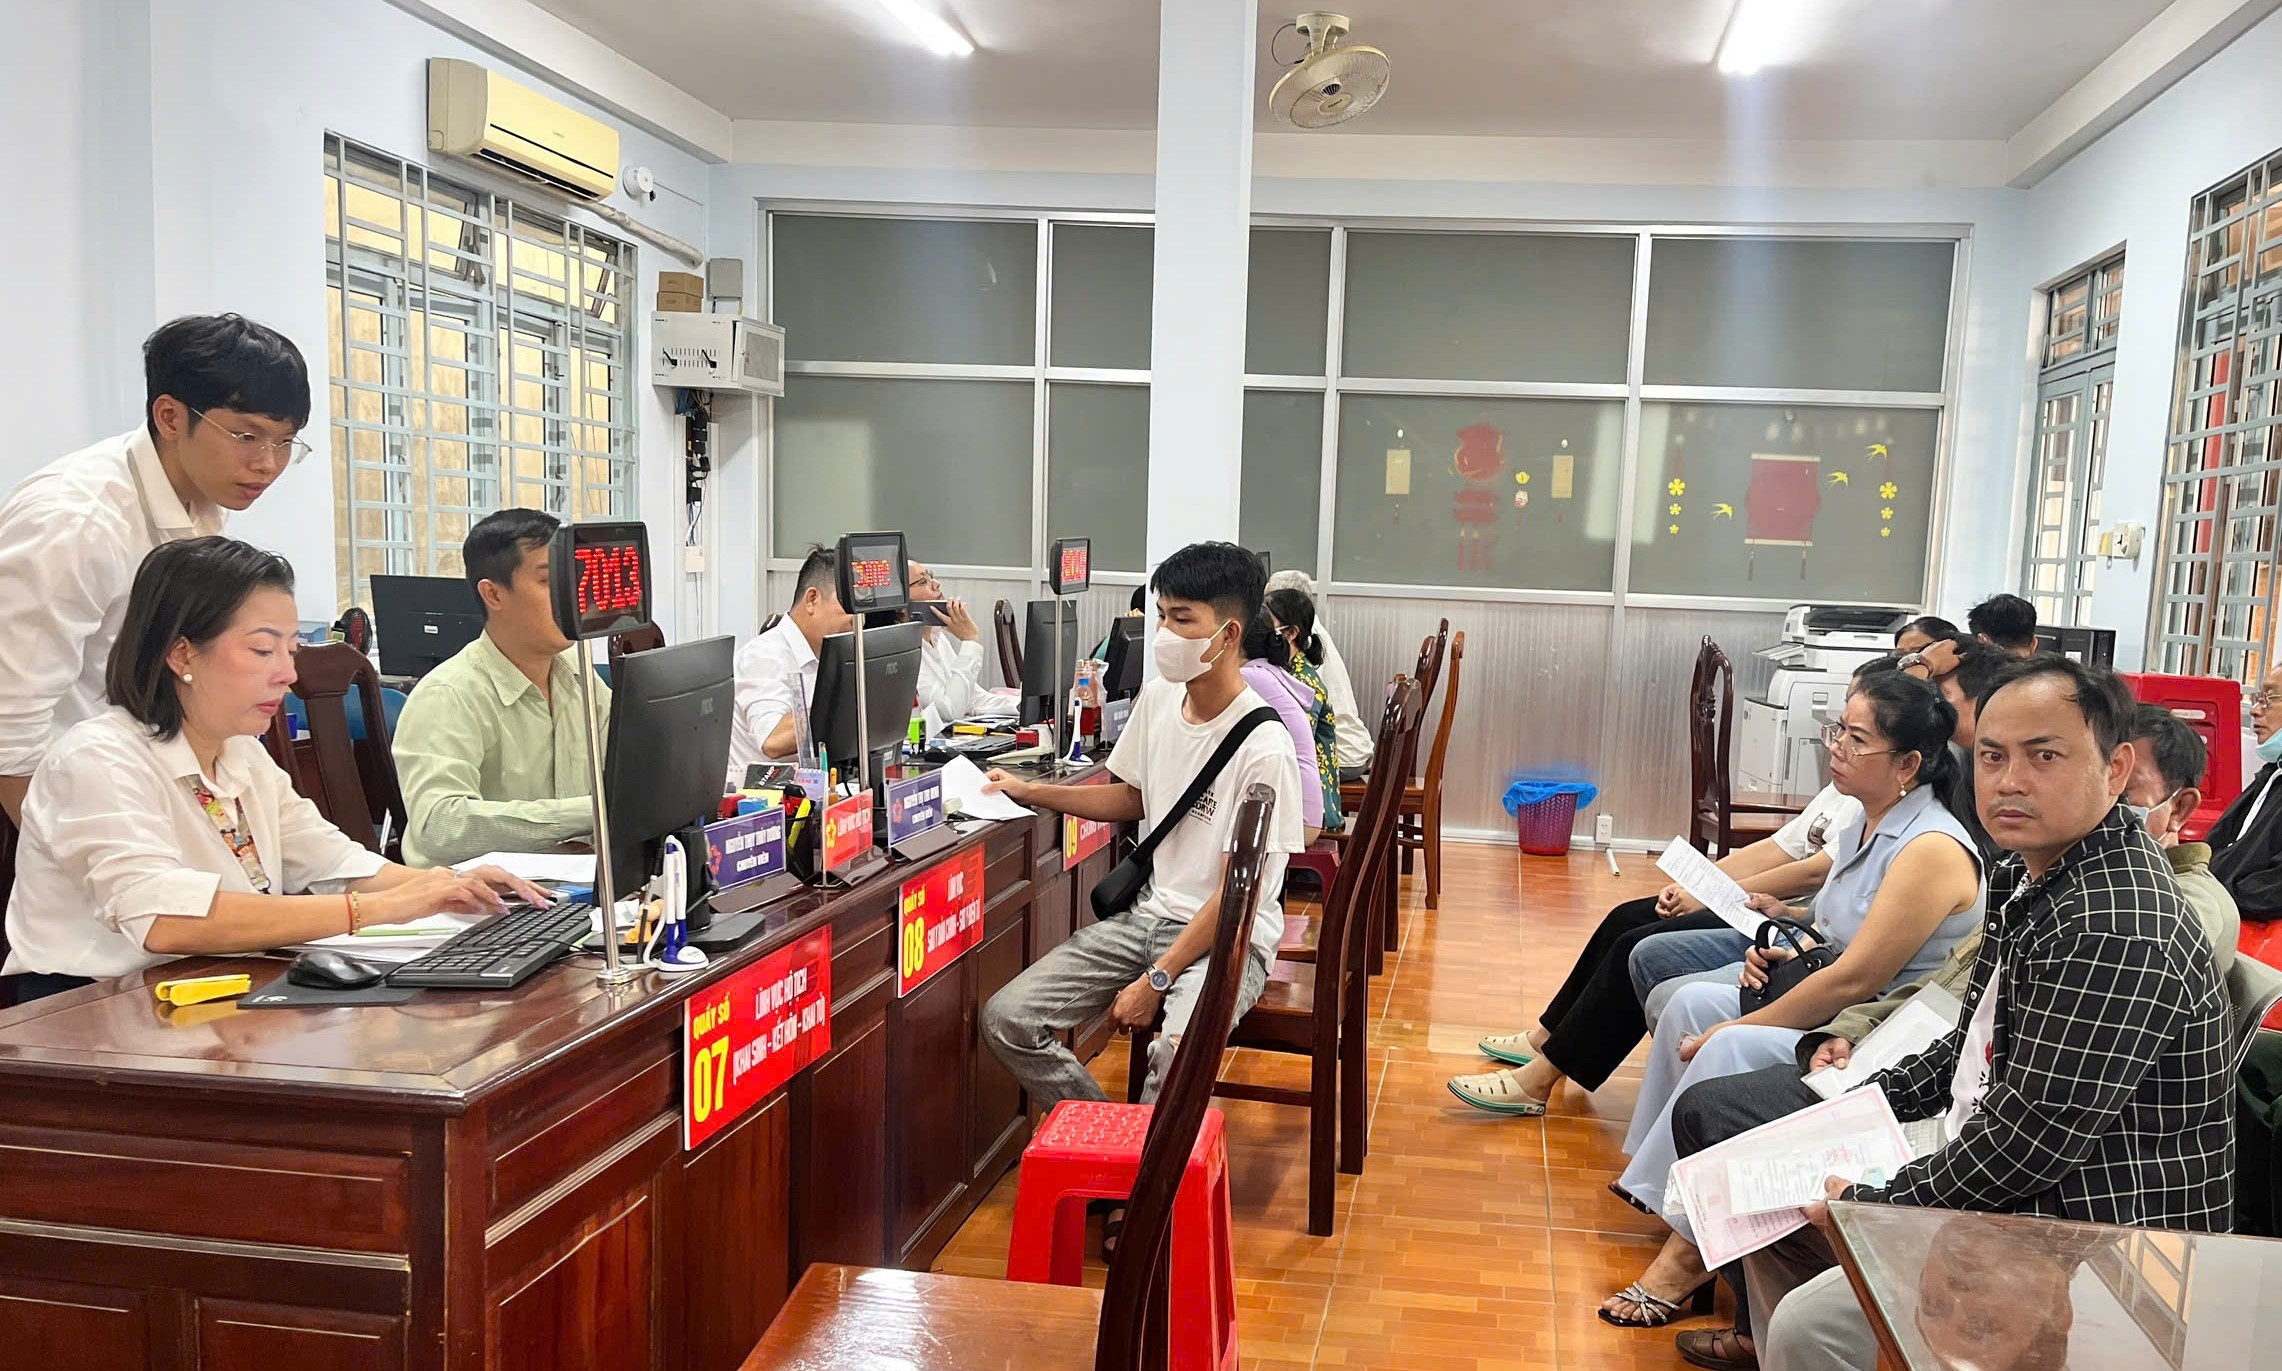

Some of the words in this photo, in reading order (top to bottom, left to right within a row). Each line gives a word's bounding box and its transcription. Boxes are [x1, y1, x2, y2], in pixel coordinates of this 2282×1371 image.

[574, 546, 640, 614] 7013
[1066, 816, 1078, 859] 09
[904, 917, 925, 978] 08
[718, 992, 730, 1024] SỐ
[751, 1034, 767, 1066] SINH
[772, 1016, 783, 1053] KẾT
[784, 1012, 798, 1046] HÔN
[694, 1035, 729, 1123] 07
